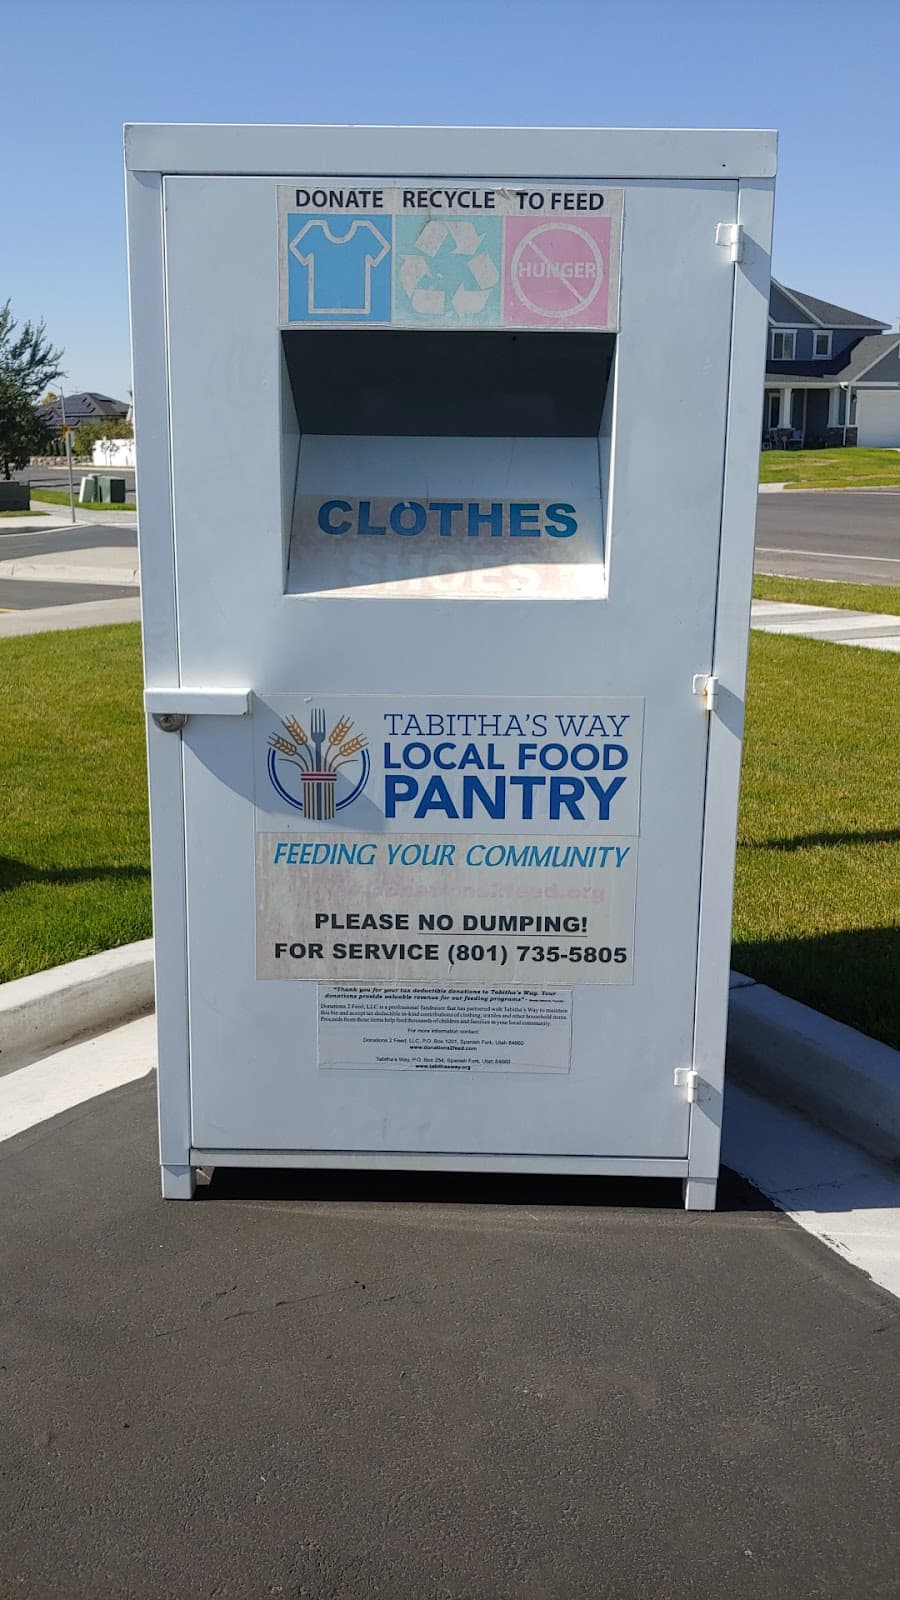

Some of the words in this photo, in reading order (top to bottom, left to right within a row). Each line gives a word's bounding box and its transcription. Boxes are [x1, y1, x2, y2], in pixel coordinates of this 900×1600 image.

[295, 189, 384, 209] DONATE
[402, 190, 496, 210] RECYCLE
[516, 192, 545, 210] TO
[551, 192, 605, 211] FEED
[518, 261, 597, 279] HUNGER
[318, 499, 578, 538] CLOTHES
[383, 713, 547, 737] TABITHA'S
[554, 714, 630, 738] WAY
[383, 742, 505, 770] LOCAL
[518, 743, 629, 771] FOOD
[384, 775, 627, 821] PANTRY
[274, 842, 377, 865] FEEDING
[386, 844, 456, 866] YOUR
[466, 845, 631, 868] COMMUNITY
[314, 913, 409, 931] PLEASE
[418, 914, 454, 931] NO
[463, 915, 588, 933] DUMPING!
[274, 943, 325, 959] FOR
[332, 943, 440, 960] SERVICE
[447, 944, 508, 965] (801)
[517, 945, 628, 964] 735-5805
